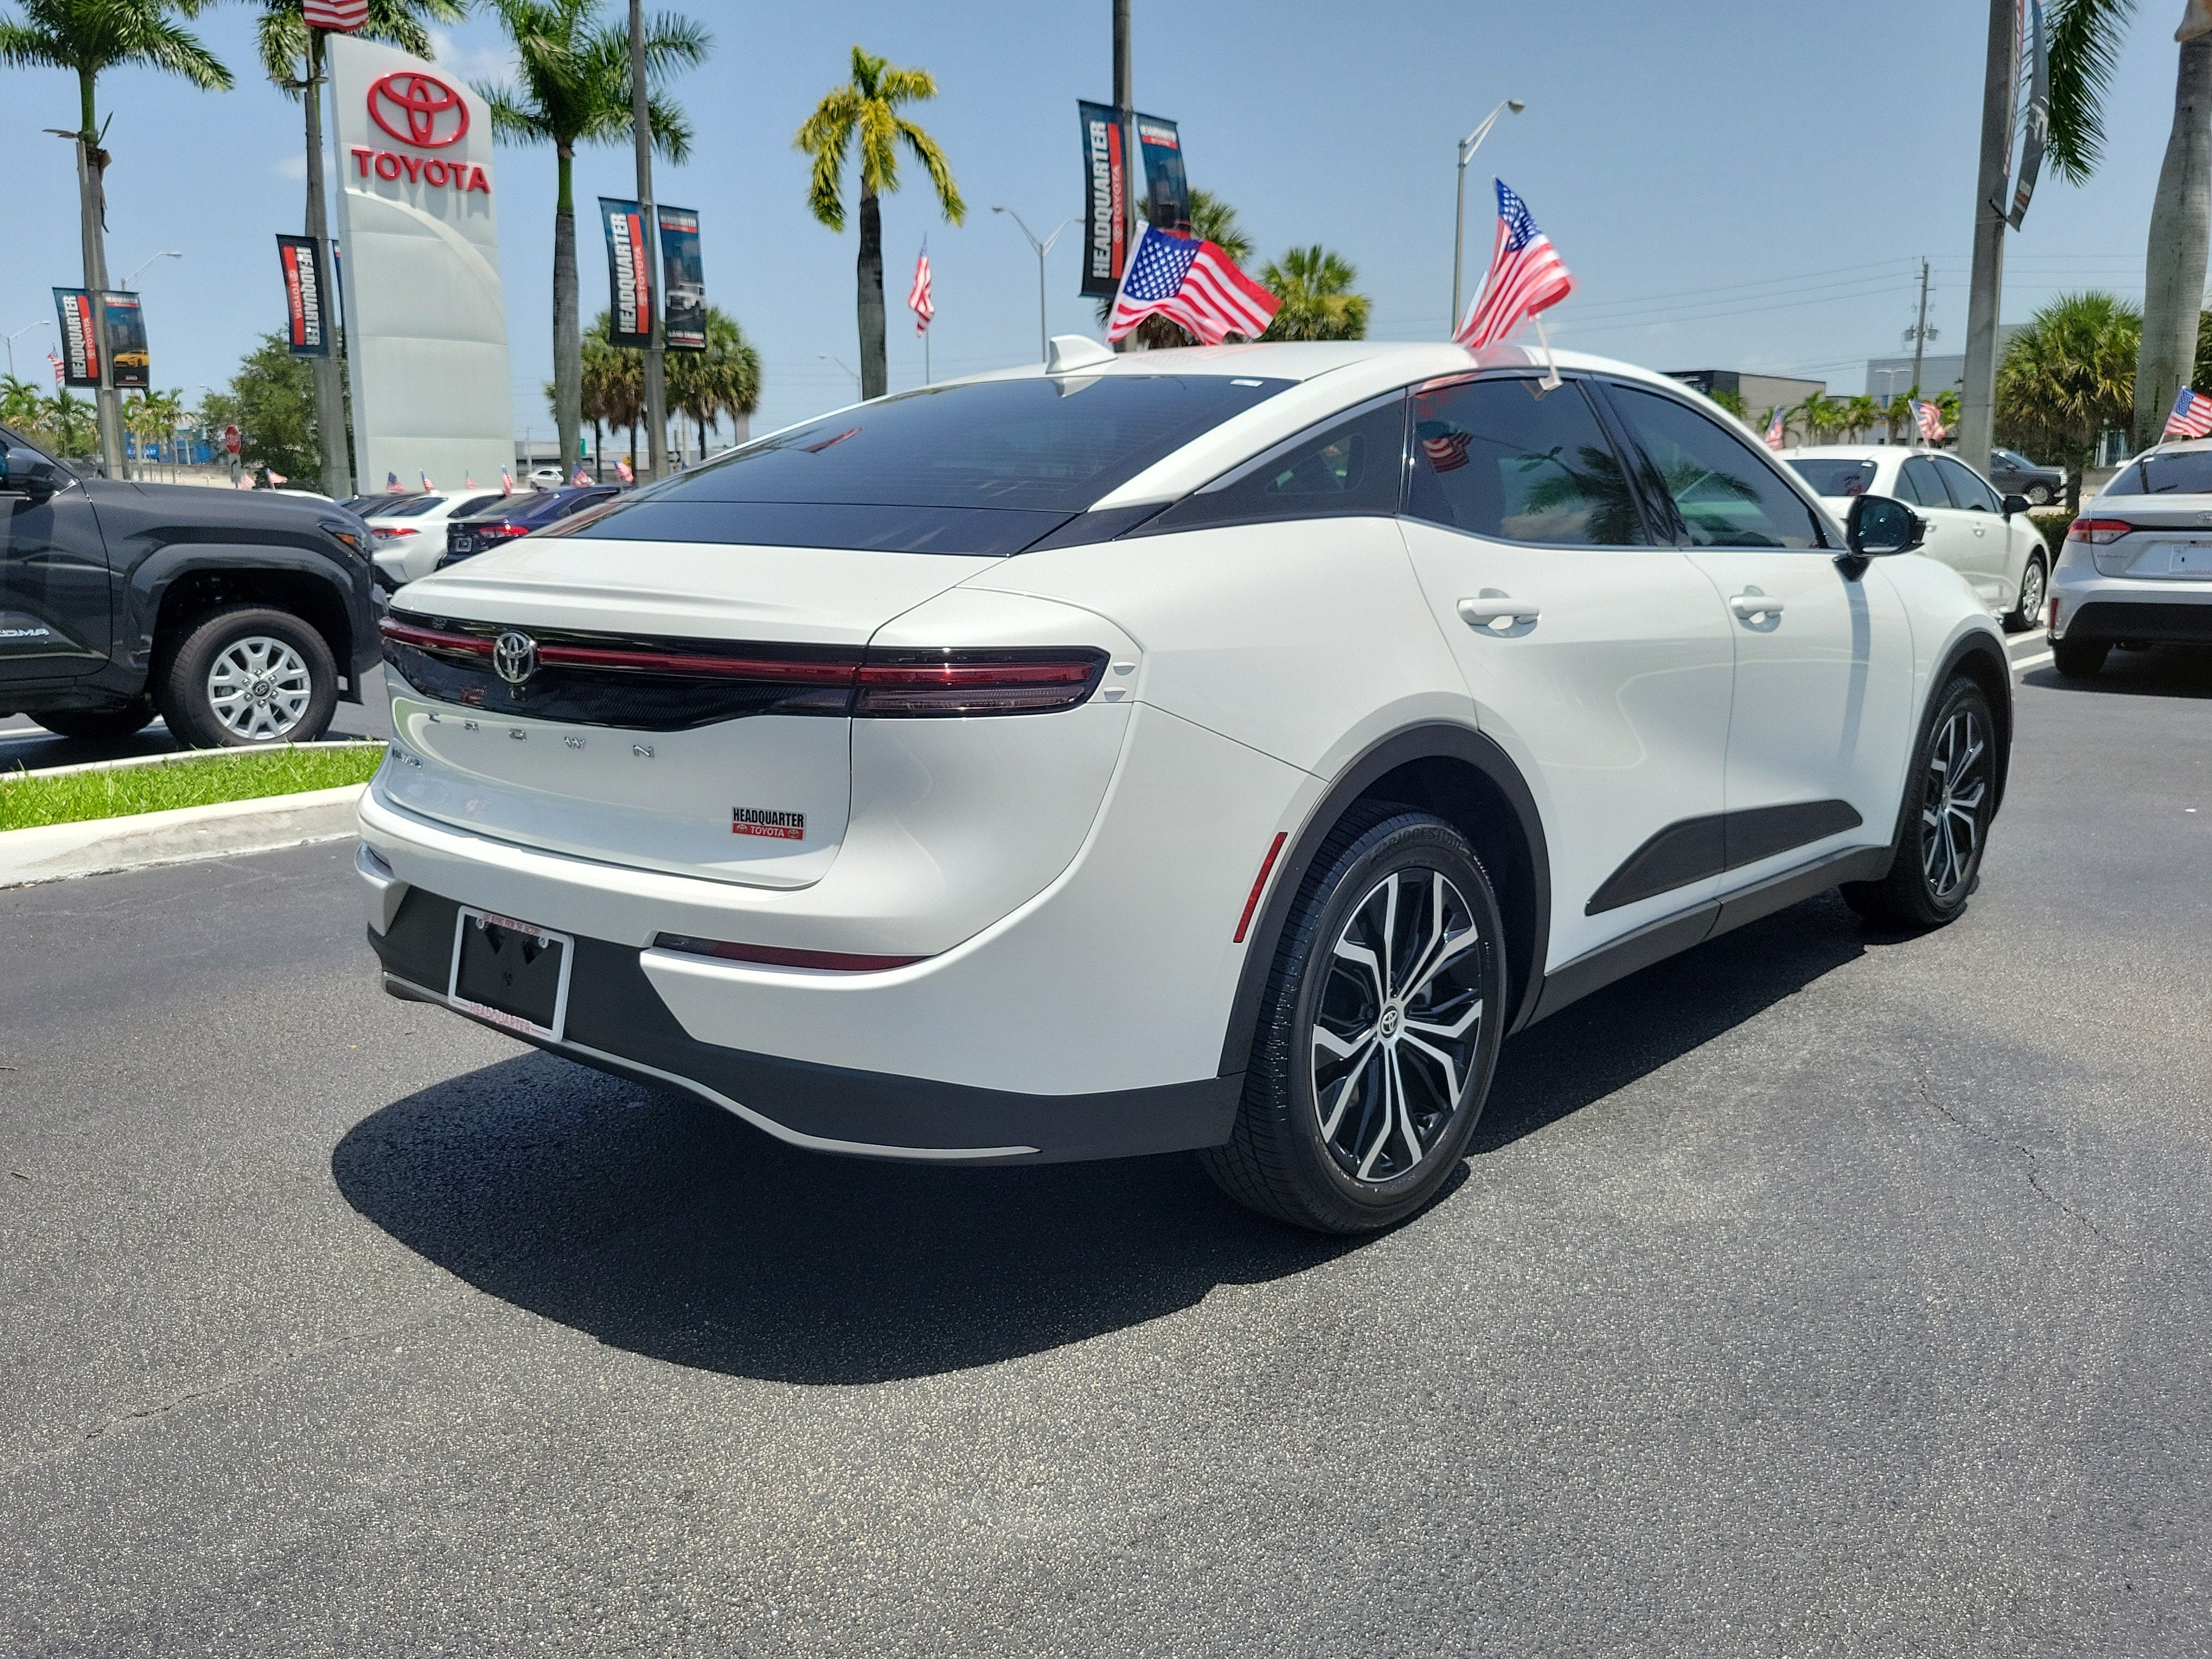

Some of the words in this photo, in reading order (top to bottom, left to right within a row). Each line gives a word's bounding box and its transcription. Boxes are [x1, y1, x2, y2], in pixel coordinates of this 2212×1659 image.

[351, 149, 492, 194] TOYOTA
[1090, 120, 1112, 279] HEADQUARTER
[1111, 165, 1122, 225] TOYOTA
[296, 246, 320, 346] HEADQUARTER
[610, 213, 636, 334] HEADQUARTER
[63, 295, 87, 379] HEADQUARTER
[733, 808, 804, 828] HEADQUARTER
[750, 825, 785, 837] TOYOTA
